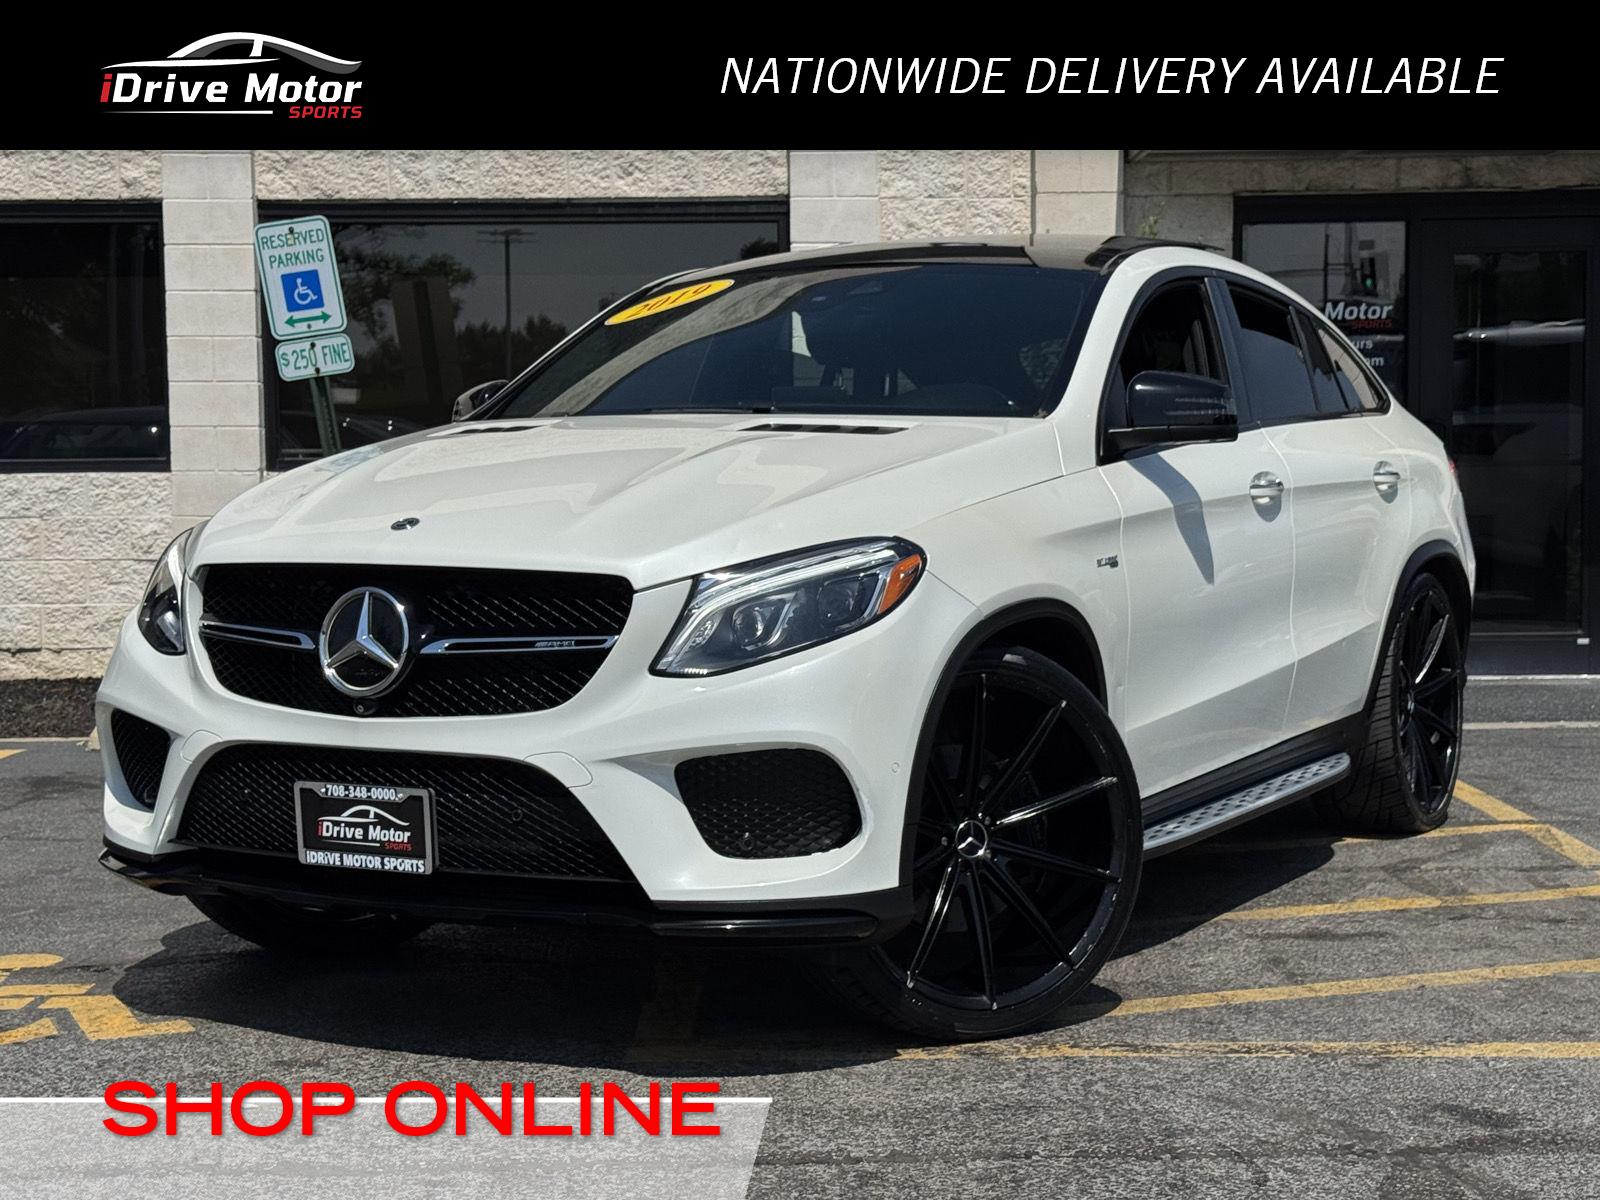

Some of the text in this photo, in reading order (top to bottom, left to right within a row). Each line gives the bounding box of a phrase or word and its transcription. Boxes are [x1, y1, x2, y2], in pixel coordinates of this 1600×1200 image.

[260, 228, 325, 250] RESERVED
[269, 249, 325, 269] PARKING
[625, 284, 712, 320] 2019
[1324, 301, 1393, 320] Motor
[321, 342, 351, 366] FINE
[317, 821, 411, 843] iDrive Motor
[384, 842, 412, 851] SPORTS
[342, 853, 382, 869] MOTOR
[383, 857, 425, 873] SPORTS
